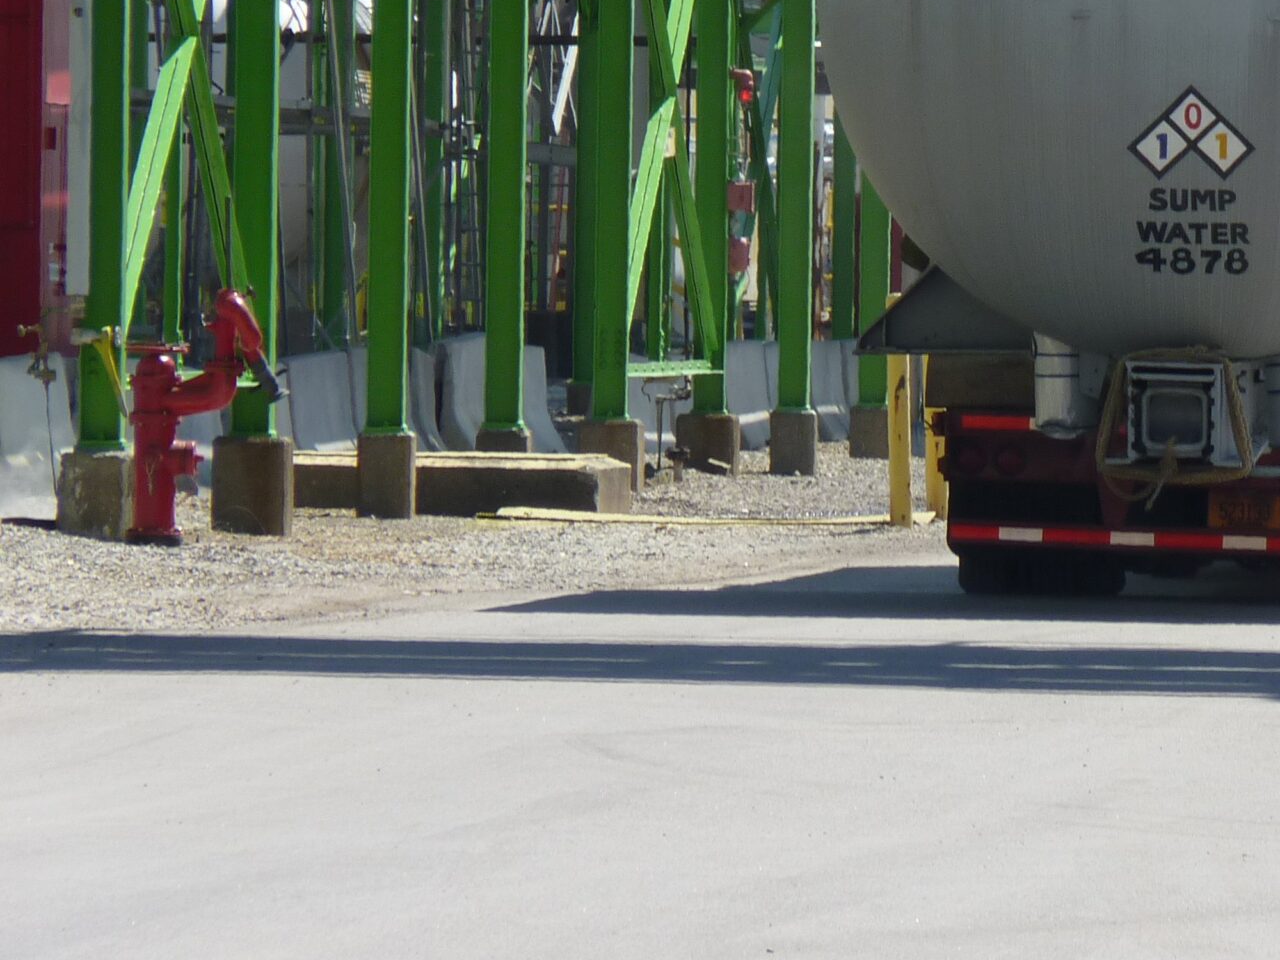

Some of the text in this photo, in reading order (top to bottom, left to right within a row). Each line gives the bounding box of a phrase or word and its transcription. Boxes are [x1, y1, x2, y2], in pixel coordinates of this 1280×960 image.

[1184, 103, 1202, 129] 0
[1156, 133, 1168, 160] 1
[1215, 133, 1228, 160] 1
[1149, 188, 1237, 212] SUMP
[1136, 221, 1250, 245] WATER
[1135, 247, 1249, 275] 4878
